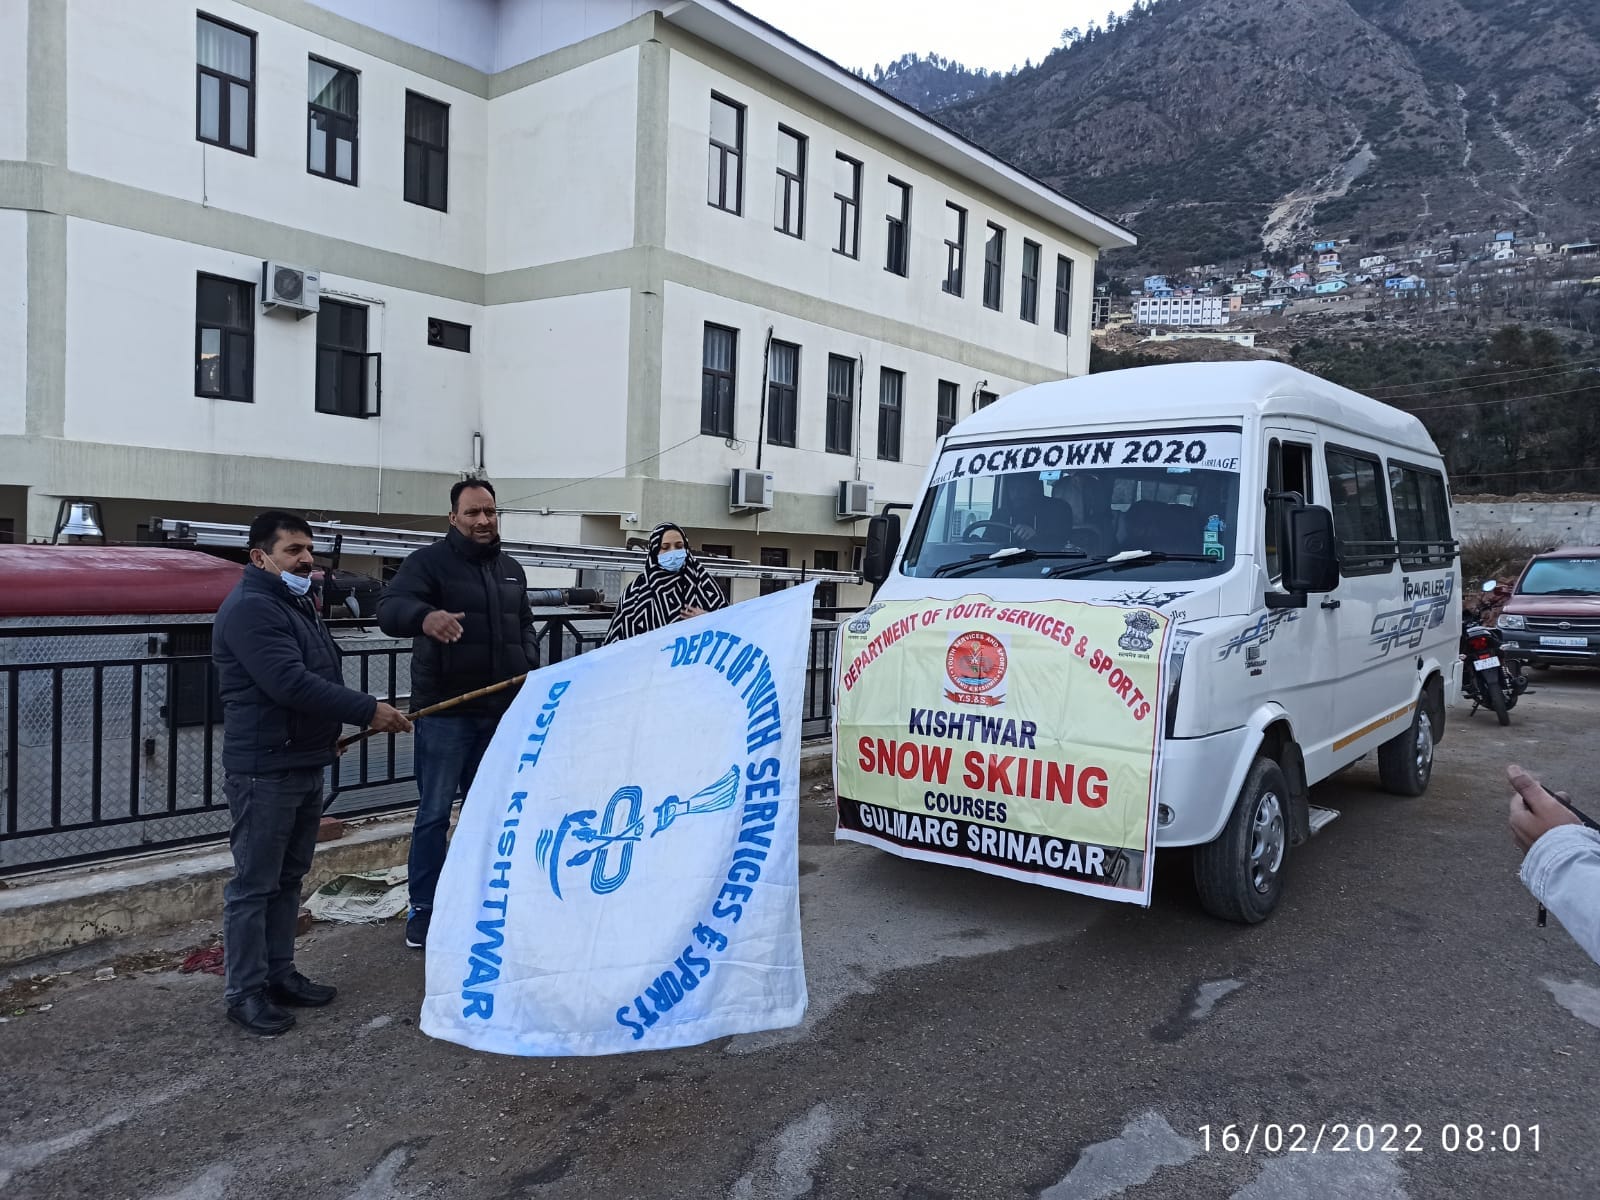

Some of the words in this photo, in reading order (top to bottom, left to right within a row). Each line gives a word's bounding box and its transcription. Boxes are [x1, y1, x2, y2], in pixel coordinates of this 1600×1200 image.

[953, 441, 1115, 478] LOCKDOWN
[1121, 440, 1207, 464] 2020
[1403, 577, 1445, 602] TRAVELLER
[671, 630, 742, 673] DEPTT.
[727, 643, 763, 686] OF
[844, 613, 919, 692] DEPARTMENT
[922, 608, 943, 626] OF
[946, 602, 998, 621] YOUTH
[996, 607, 1075, 648] SERVICES
[1075, 636, 1088, 658] &
[1089, 648, 1151, 721] SPORTS
[985, 636, 999, 648] AND
[518, 679, 571, 774] DISTT.
[741, 654, 782, 755] YOUTH
[909, 707, 1038, 750] KISHTWAR
[858, 736, 953, 785] SNOW
[962, 751, 1109, 809] SKIING
[924, 790, 1008, 824] COURSES
[712, 757, 781, 924] SERVICES
[859, 803, 959, 847] GULMARG
[967, 828, 1105, 877] SRINAGAR
[463, 790, 528, 1021] KISHTWAR
[692, 921, 728, 952] &
[616, 944, 711, 1041] SPORTS
